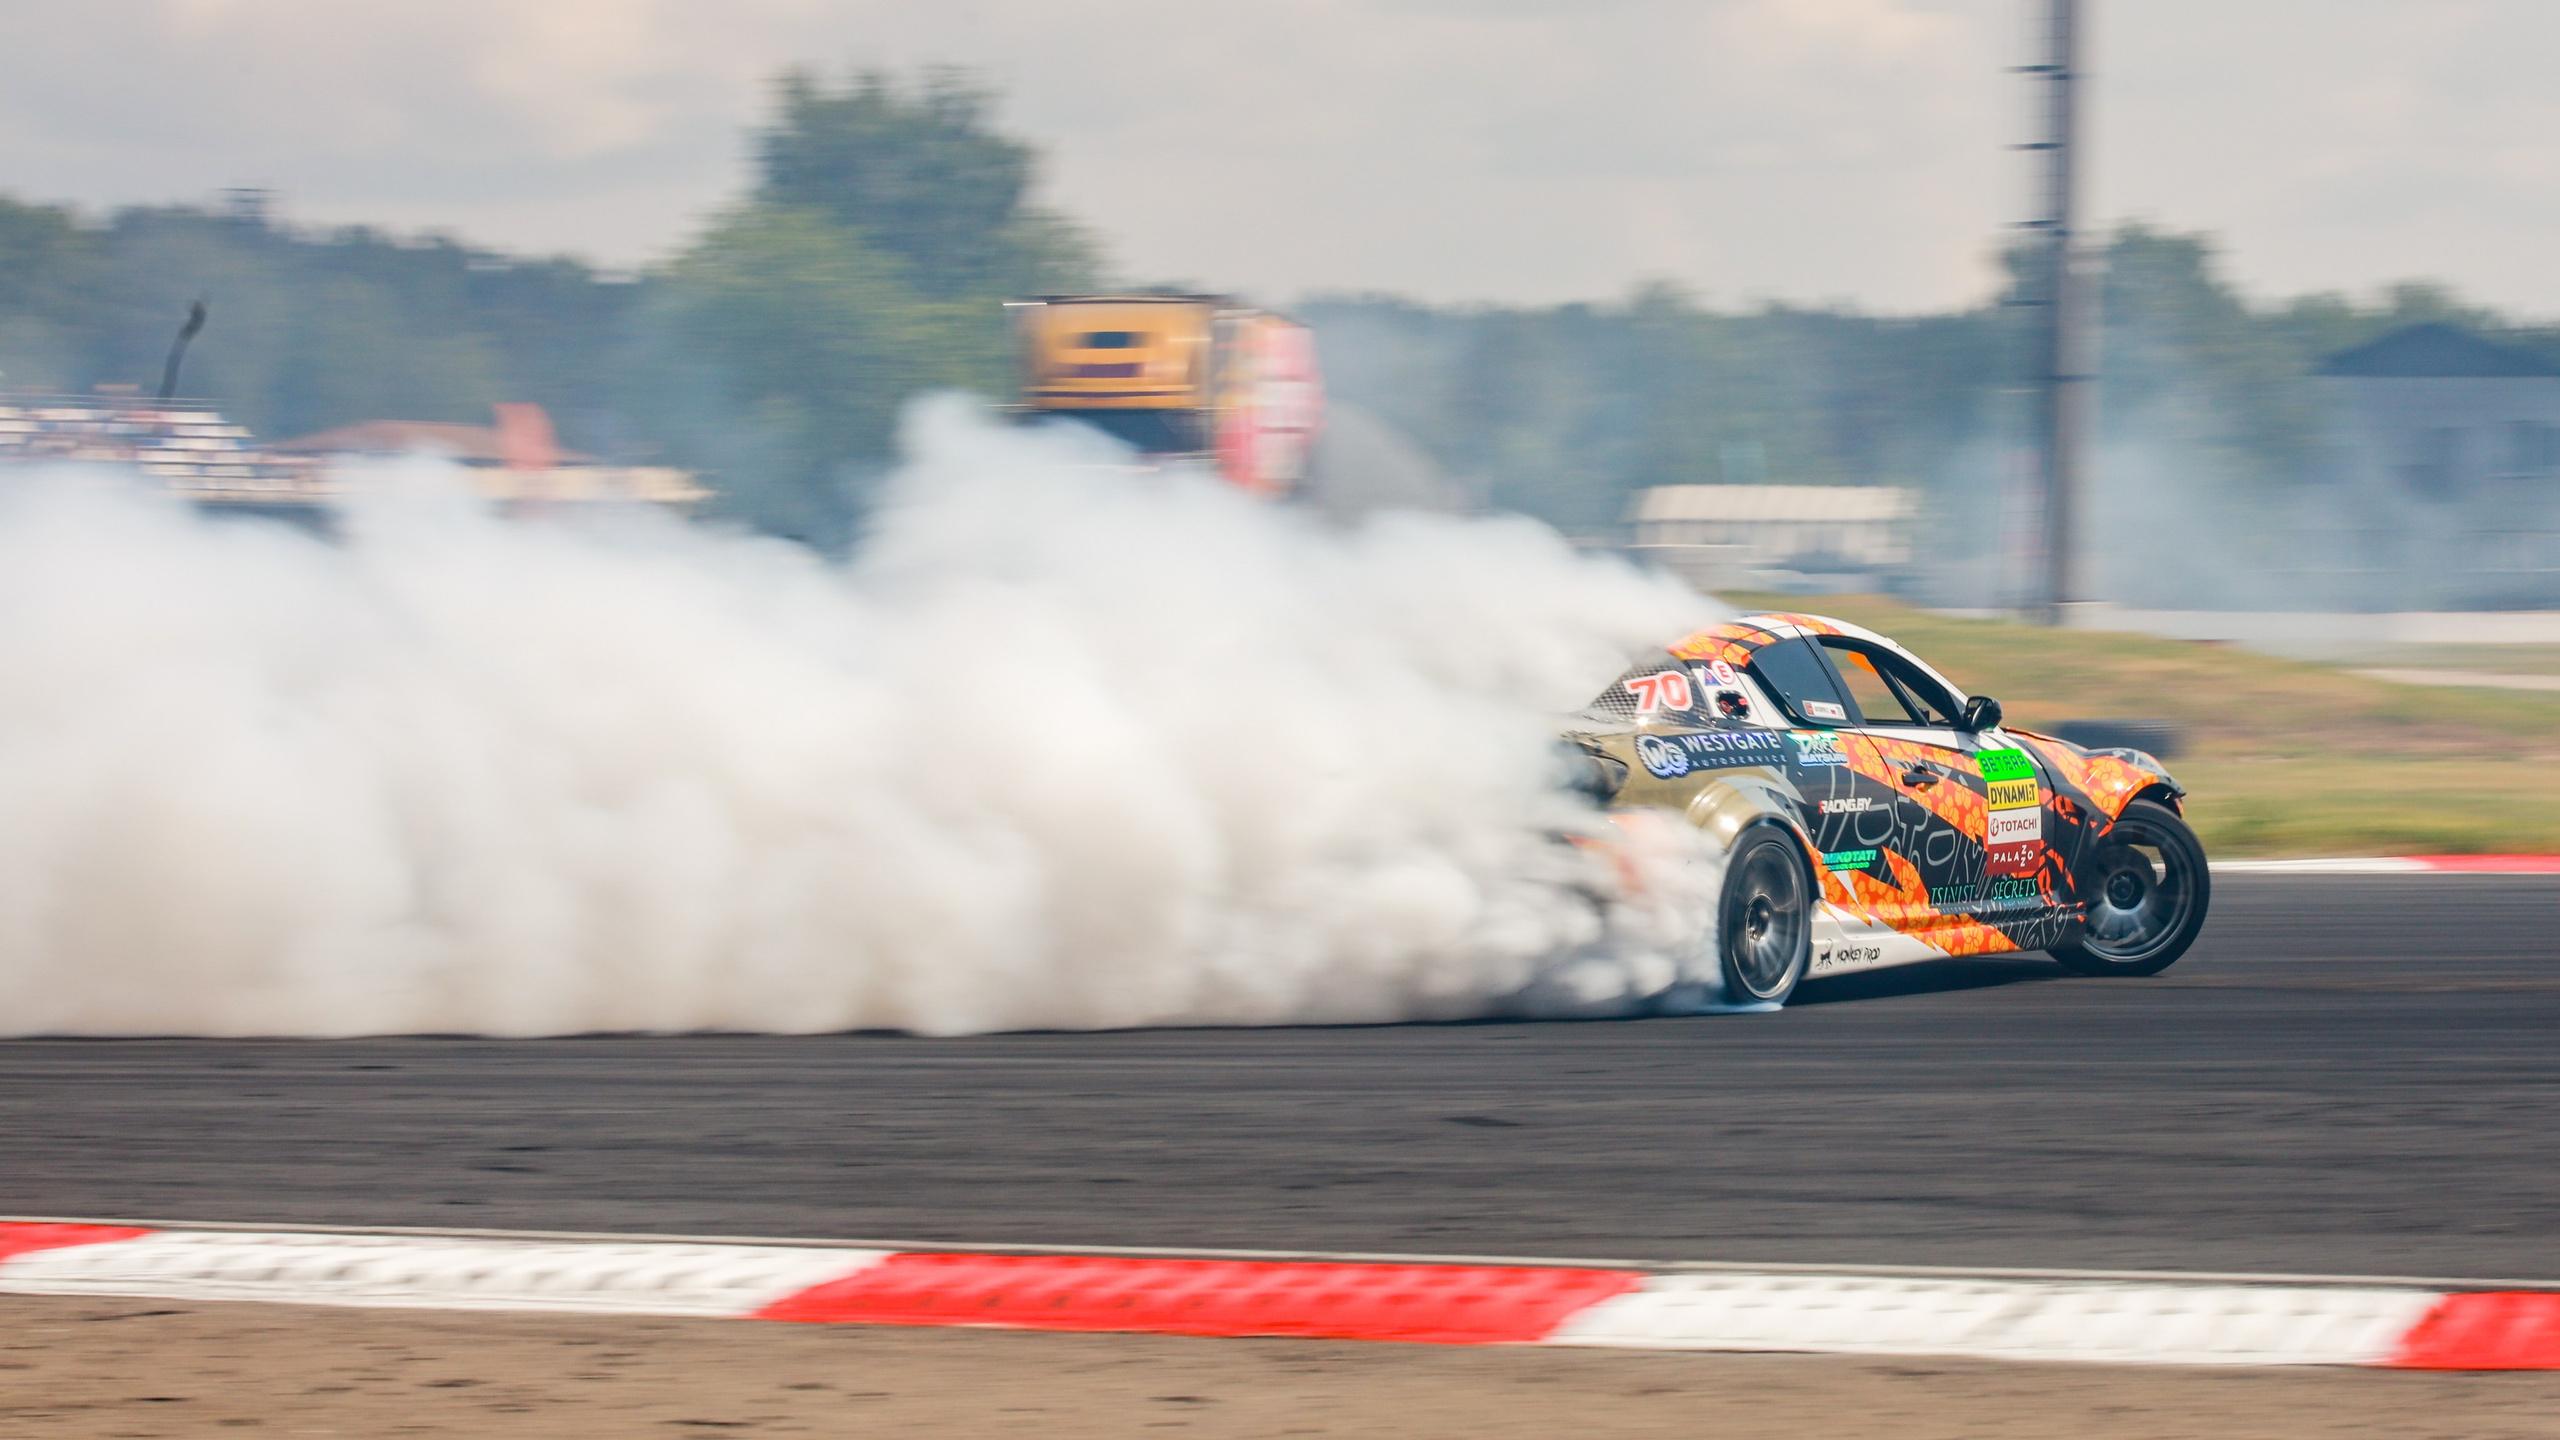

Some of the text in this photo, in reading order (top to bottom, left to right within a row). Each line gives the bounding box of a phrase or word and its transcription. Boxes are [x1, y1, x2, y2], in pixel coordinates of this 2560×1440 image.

[1625, 672, 1690, 712] 70
[1679, 732, 1781, 753] WESTGATE
[1692, 754, 1787, 768] AUTOSERVICE
[1798, 752, 1848, 765] MATSURI
[1819, 797, 1872, 814] RACING.BY
[2000, 818, 2037, 832] TOTACHI
[1823, 850, 1877, 864] MIKOTATI
[1993, 844, 2034, 867] PALAZZO
[1993, 878, 2037, 900] SECRETS
